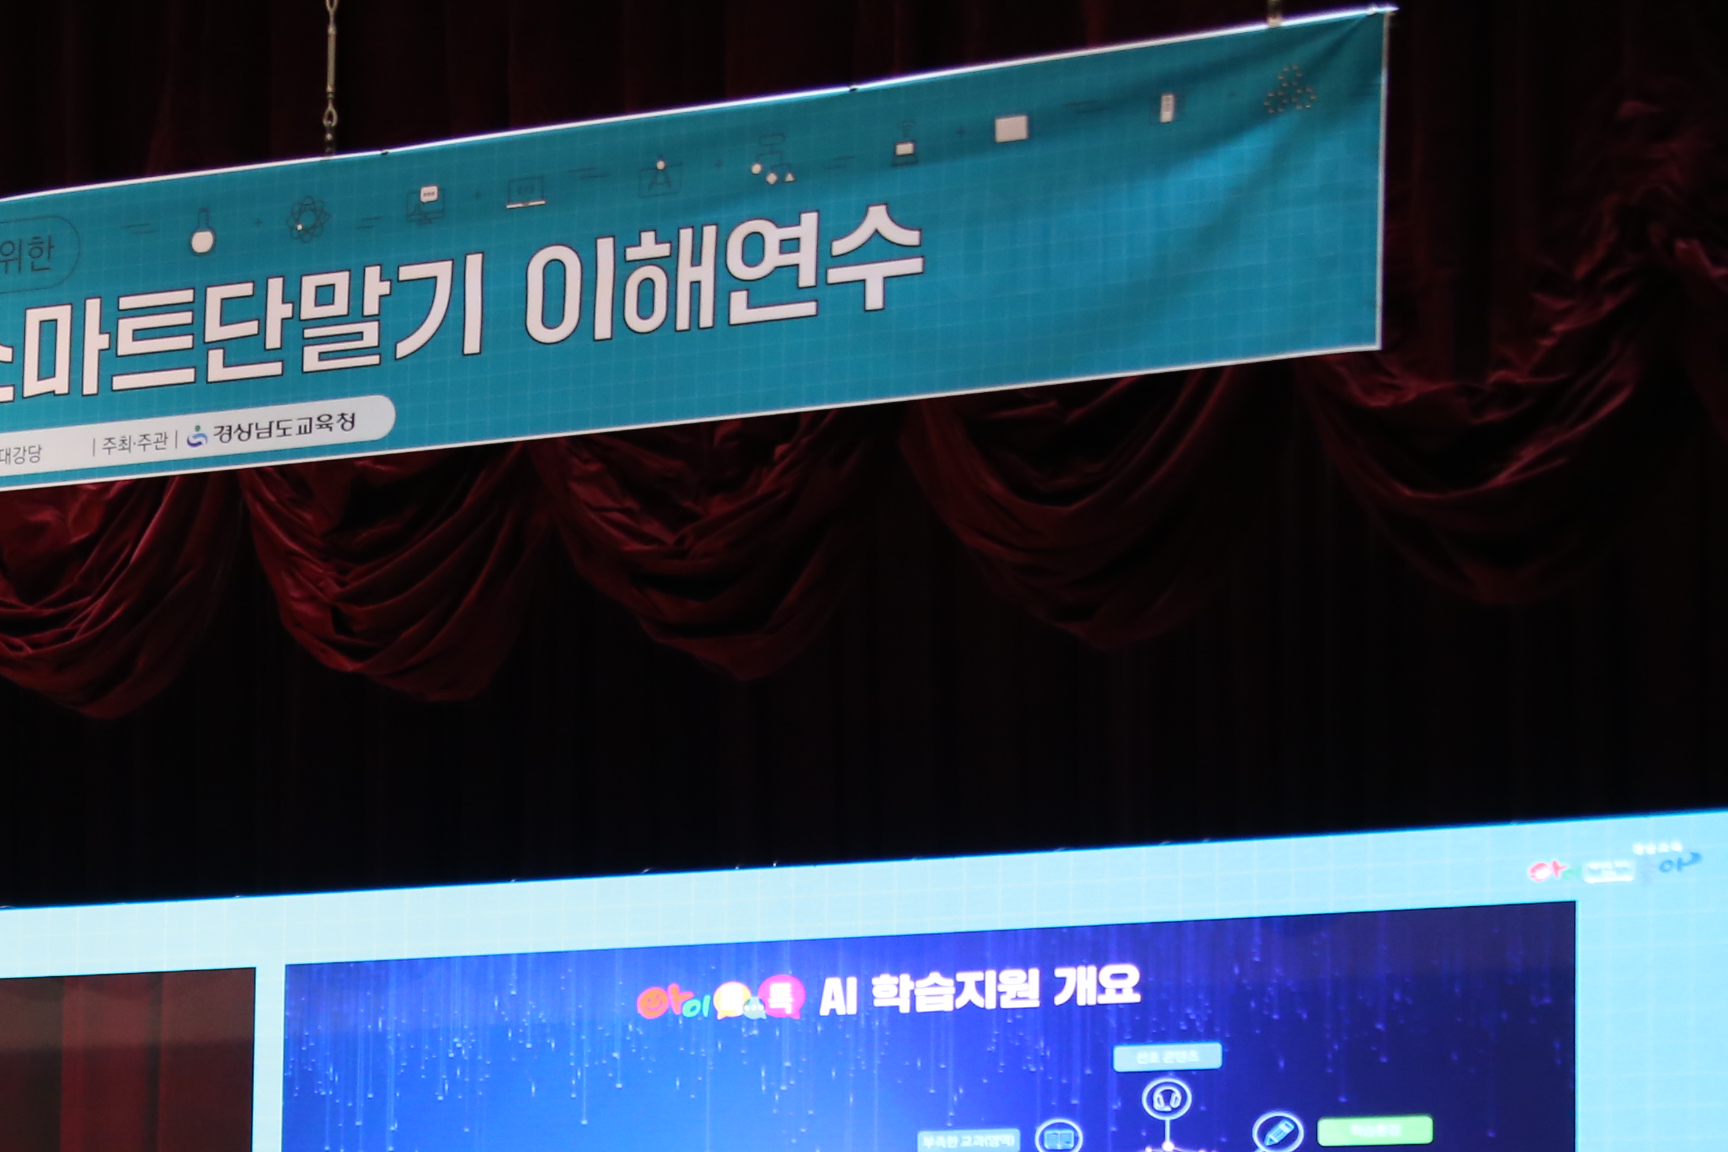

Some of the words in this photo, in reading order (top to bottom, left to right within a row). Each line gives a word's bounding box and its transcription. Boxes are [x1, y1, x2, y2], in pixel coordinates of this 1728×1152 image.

[524, 203, 925, 345] 이해연수
[213, 412, 357, 444] 경상남도교육청
[819, 976, 858, 1017] AI
[872, 967, 1040, 1014] 학습지원
[1054, 963, 1141, 1007] 개요
